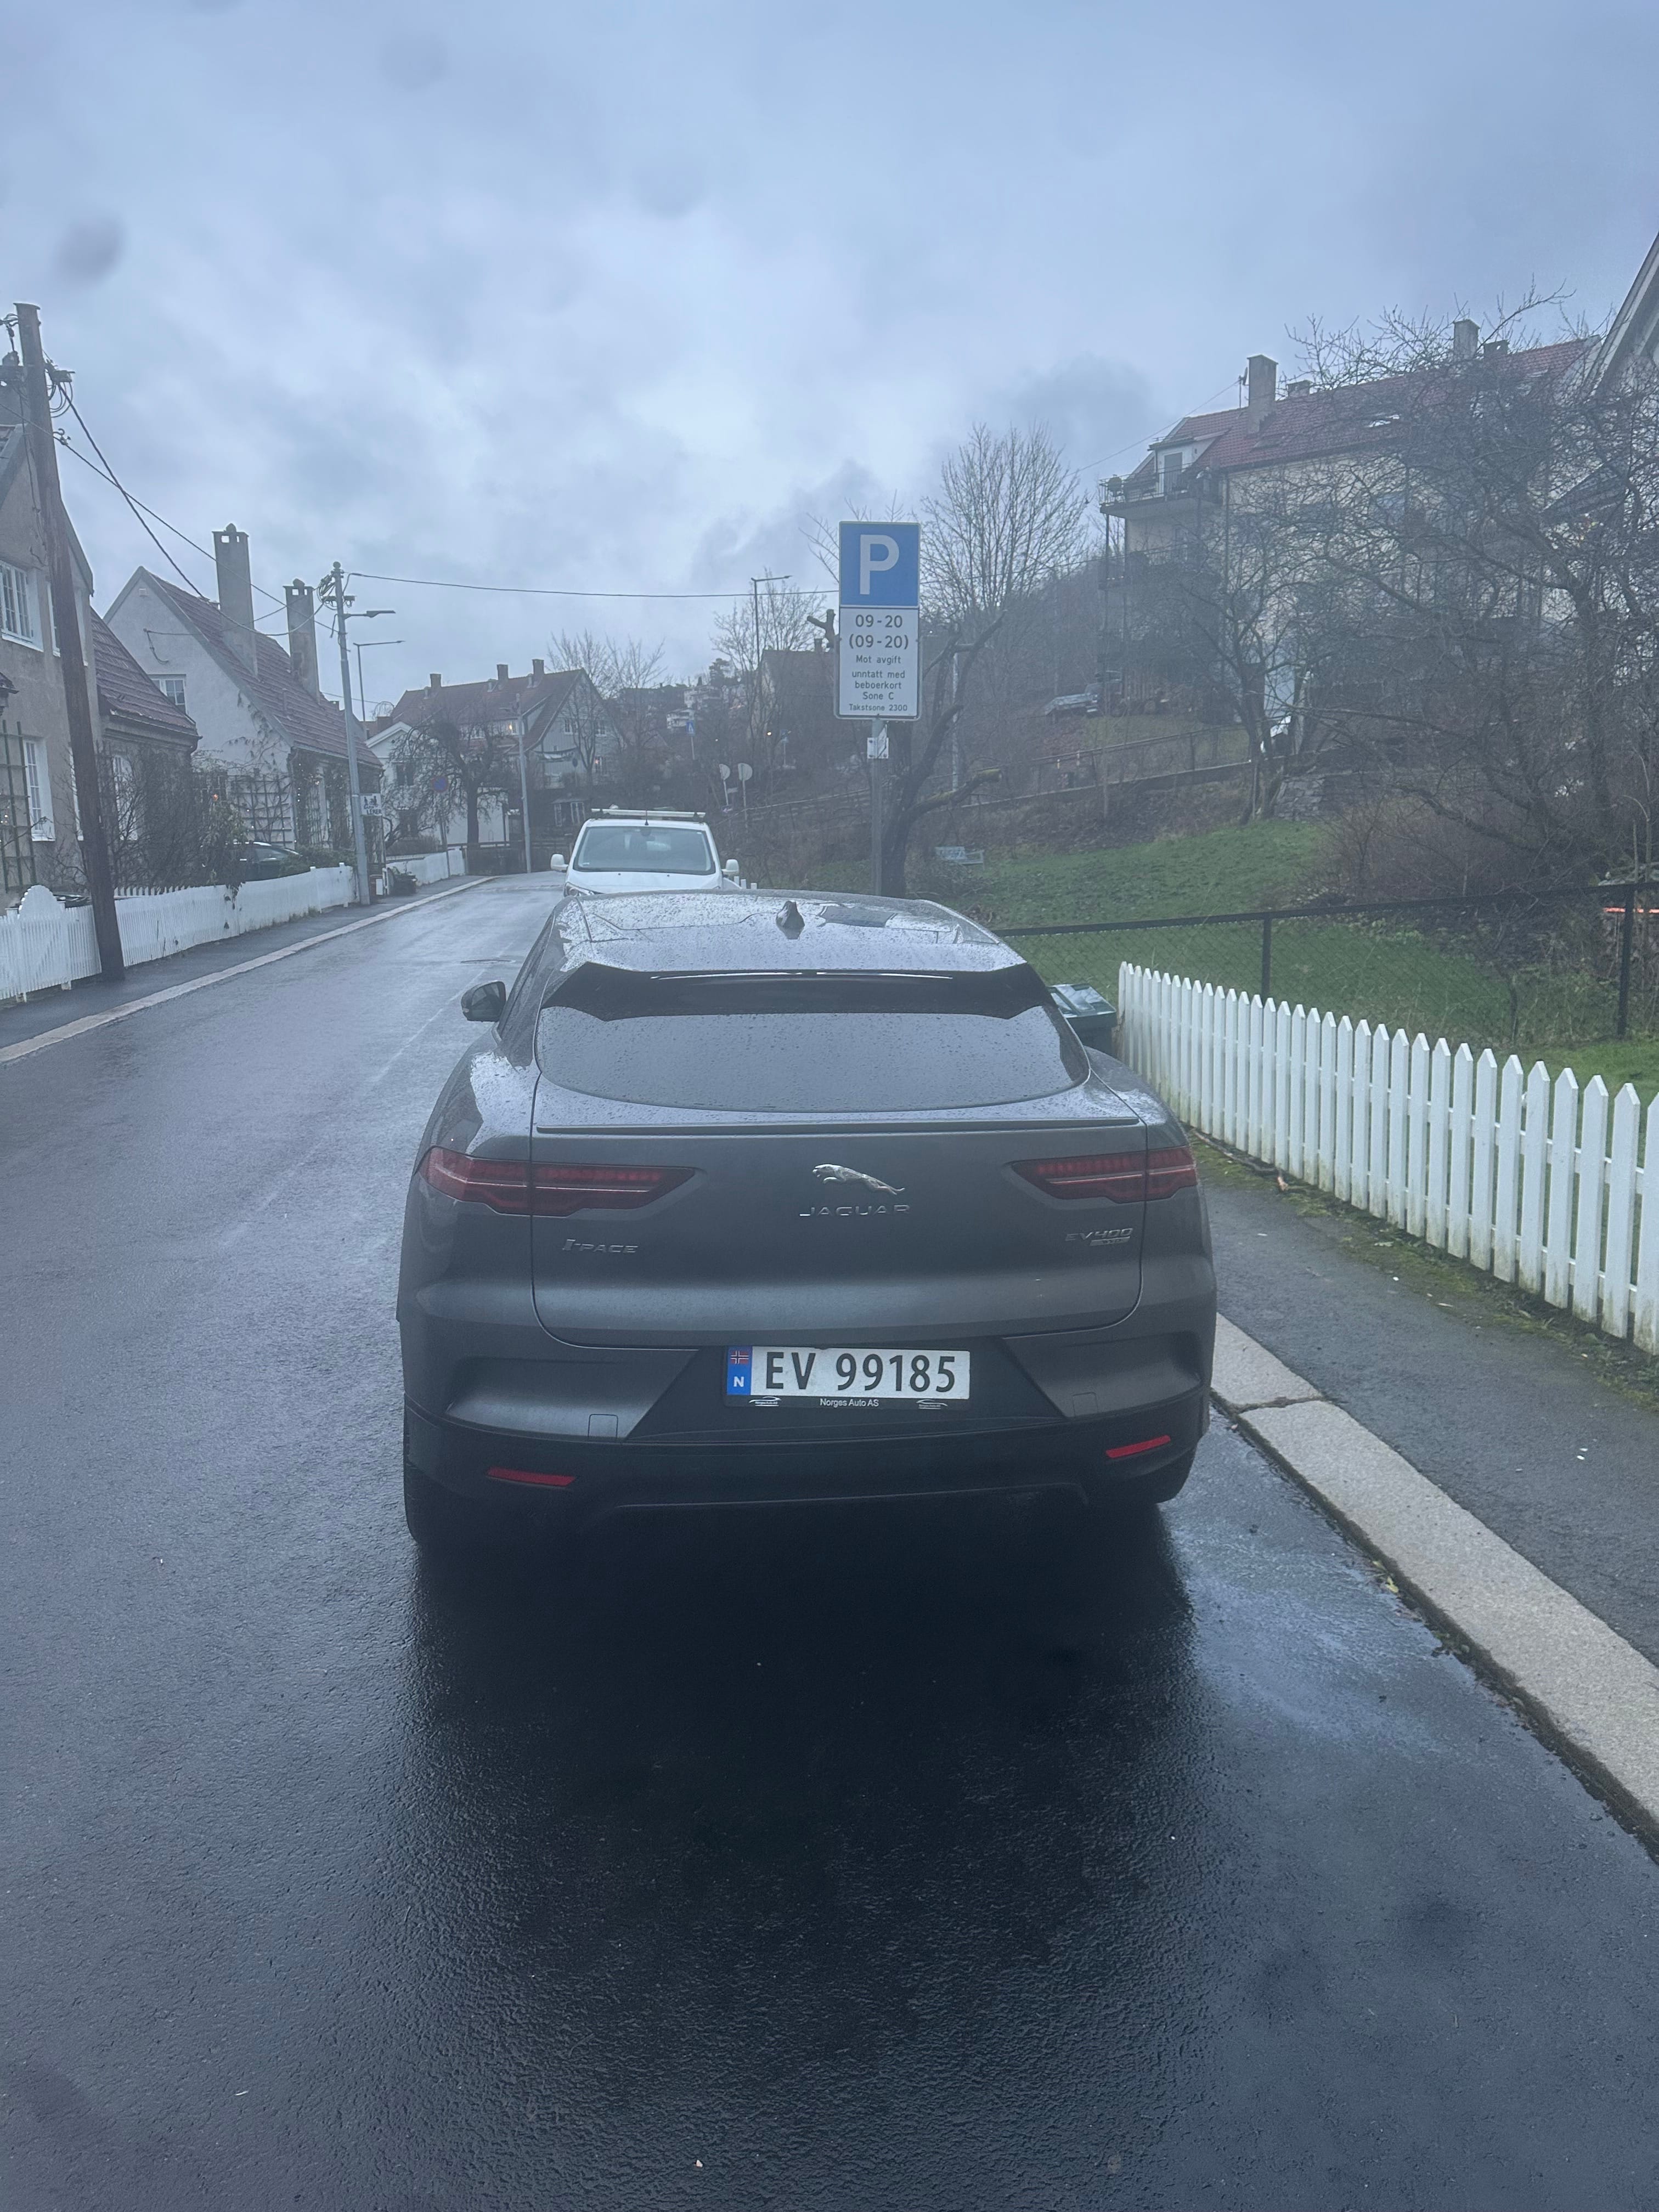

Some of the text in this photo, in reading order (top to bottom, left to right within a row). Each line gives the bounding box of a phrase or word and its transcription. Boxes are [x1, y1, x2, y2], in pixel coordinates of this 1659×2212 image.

[860, 534, 900, 595] P
[856, 654, 901, 665] Mot avgift
[852, 670, 905, 679] unntatt med
[855, 681, 901, 689] beboerkort
[862, 691, 894, 700] Sone C
[799, 1204, 911, 1216] JAGUAR
[1065, 1228, 1133, 1242] EV400
[766, 1351, 955, 1393] EV 99185
[733, 1376, 744, 1387] N
[820, 1398, 879, 1408] Norges Auto AS
